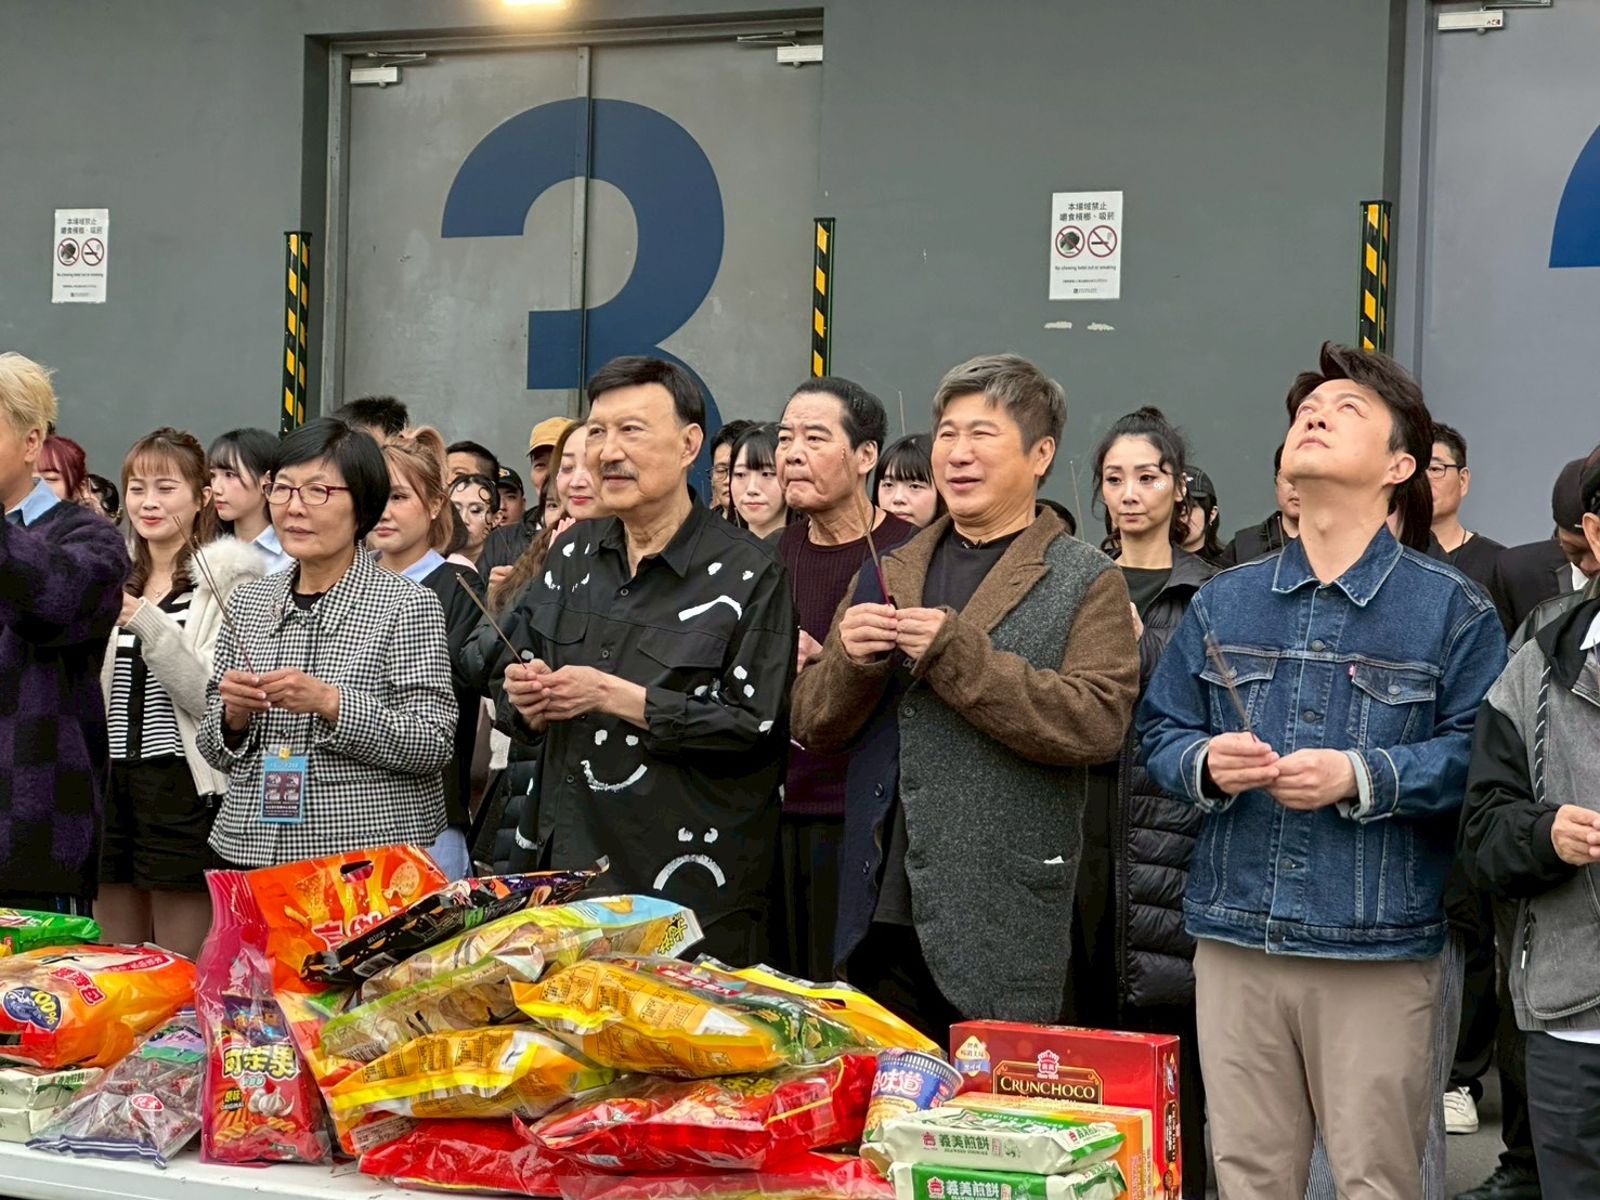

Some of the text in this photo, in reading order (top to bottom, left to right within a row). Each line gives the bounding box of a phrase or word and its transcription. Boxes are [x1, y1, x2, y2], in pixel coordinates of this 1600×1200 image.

[441, 97, 725, 505] 3
[1000, 1076, 1095, 1099] CRUNCHOCO
[939, 1134, 989, 1150] 義美煎餅
[946, 1180, 999, 1198] 義美煎餅
